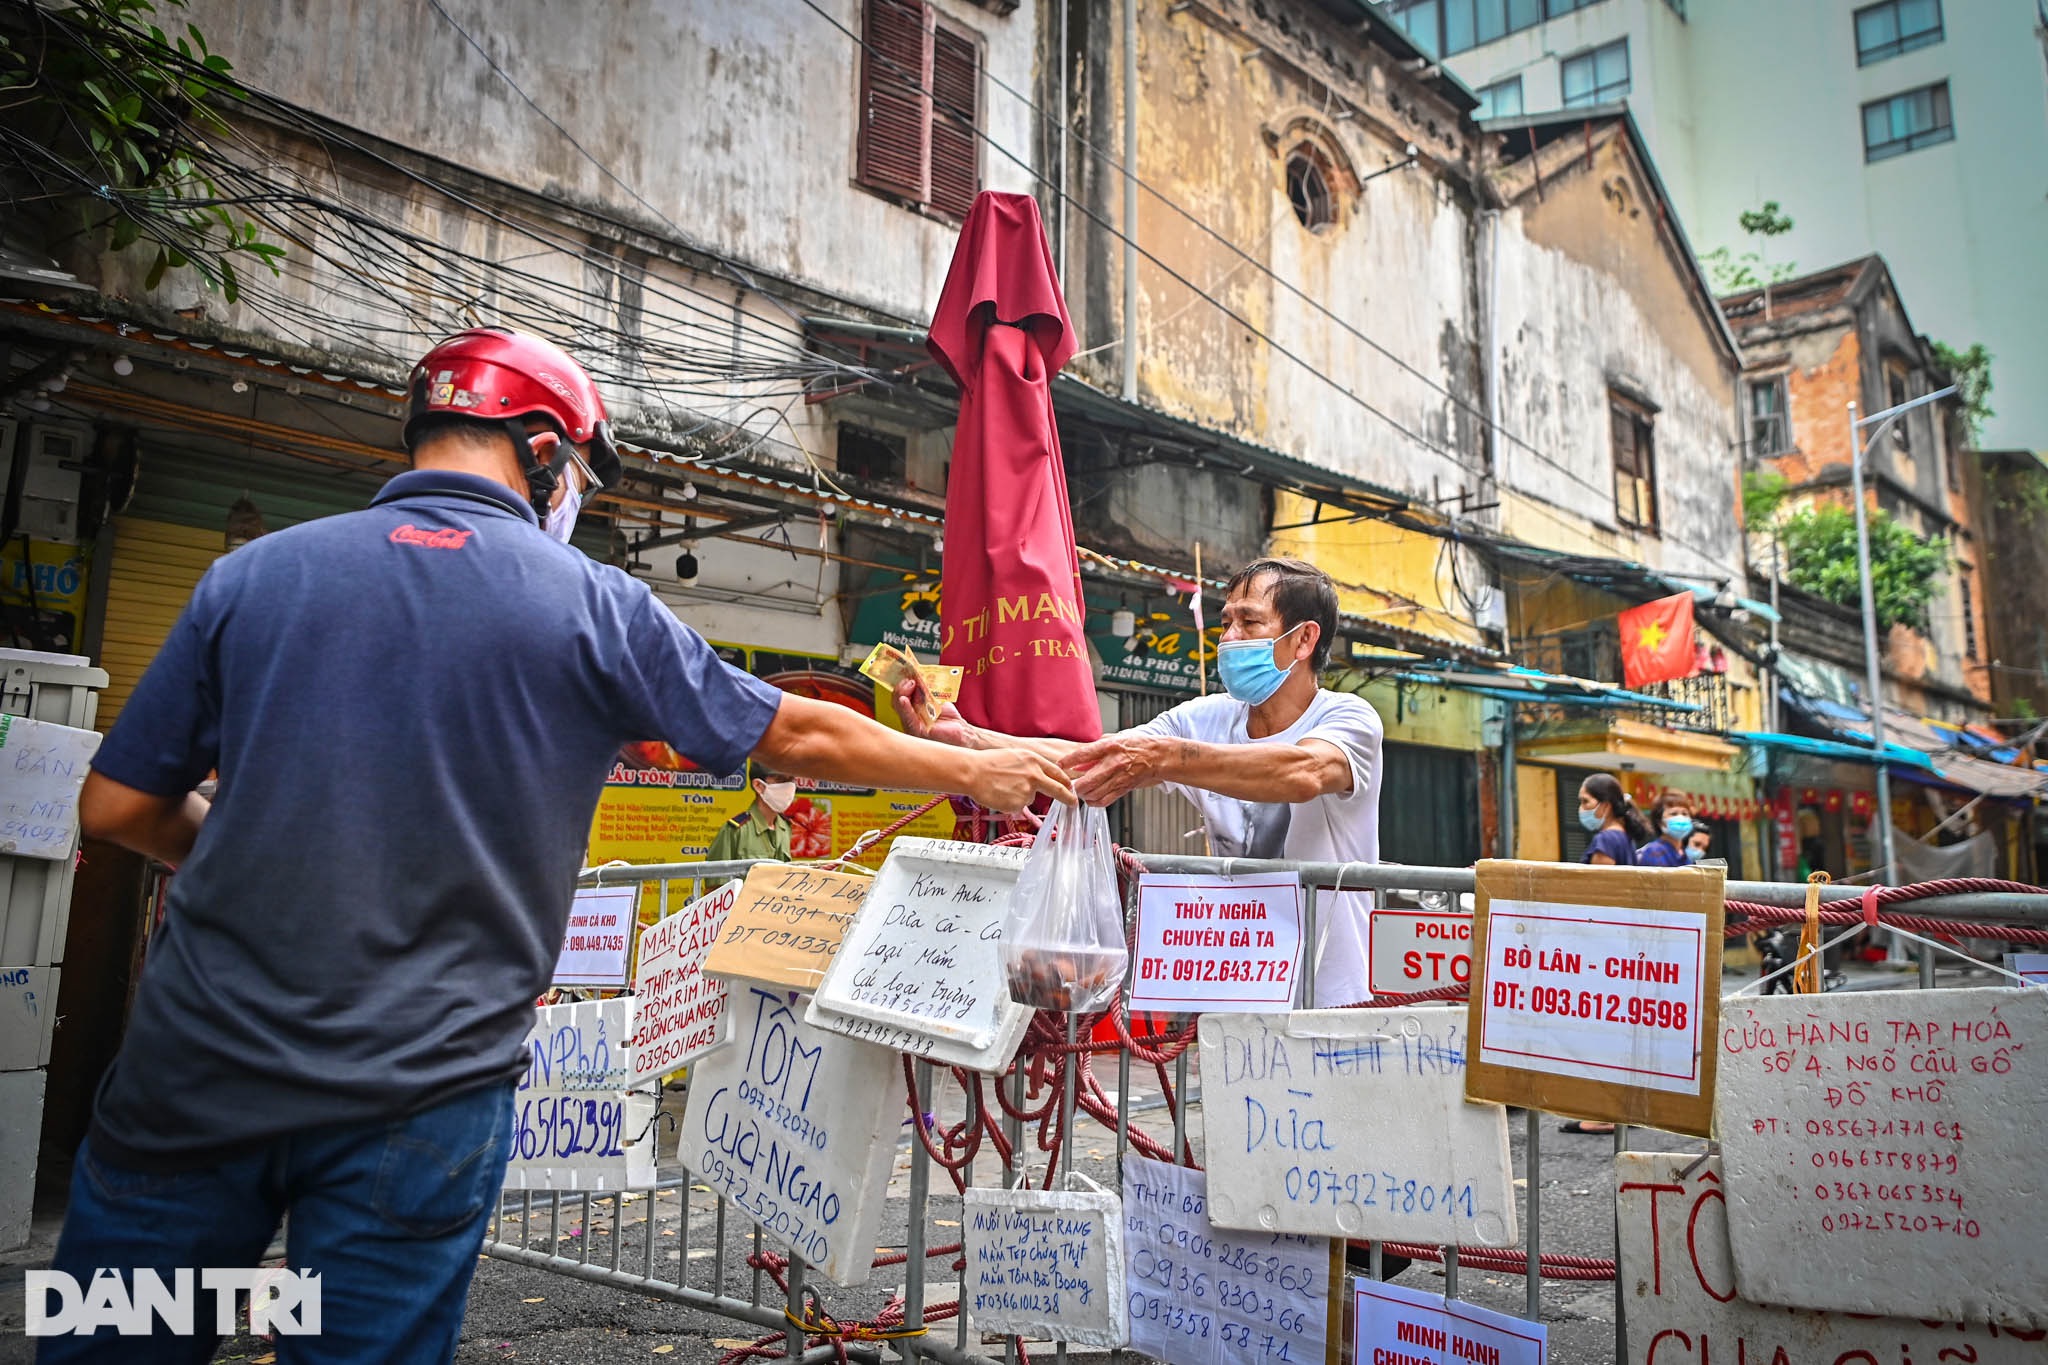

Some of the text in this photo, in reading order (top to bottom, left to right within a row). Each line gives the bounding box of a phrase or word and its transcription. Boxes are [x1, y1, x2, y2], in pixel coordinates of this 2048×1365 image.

[882, 632, 931, 649] Website:
[1123, 655, 1142, 666] 46
[1145, 657, 1183, 672] PHỐ
[681, 793, 713, 804] TÔM
[908, 871, 947, 899] Kim
[703, 888, 735, 923] KHO
[1175, 896, 1267, 920] THỦY NGHĨA
[600, 914, 617, 927] KHO
[570, 935, 624, 953] 090.449.7435
[724, 925, 764, 945] ĐT
[1162, 927, 1275, 948] CHUYÊN GÀ TA
[1141, 957, 1289, 982] ĐT: 0912.643.712
[1503, 943, 1532, 970] BÒ
[1538, 948, 1581, 975] LÂN
[1604, 952, 1680, 985] CHỈNH
[1493, 981, 1688, 1031] ĐT: 093.612.9598
[832, 1015, 935, 1056] 0967956788
[1787, 1013, 1870, 1045] HÀNG
[1886, 1020, 1940, 1049] TẠP
[1951, 1006, 2013, 1042] HÓA
[635, 1024, 716, 1073] 0396011443
[746, 987, 822, 1113] TÔM
[1762, 1048, 1797, 1074] SỐ
[1846, 1048, 1897, 1073] NGÕ
[1971, 1043, 2024, 1075] GỖ
[1823, 1079, 1947, 1109] ĐỒ KHÔ
[738, 1080, 828, 1151] 0972520710
[1753, 1118, 1964, 1142] ĐT: 0856717161
[701, 1149, 829, 1264] 0972520710
[1285, 1166, 1480, 1219] 0979278011
[1815, 1183, 1964, 1211] 0367065354
[1056, 1218, 1092, 1237] RANG
[1822, 1212, 1981, 1239] 0972520710
[1397, 1321, 1500, 1365] MINH HẠNH
